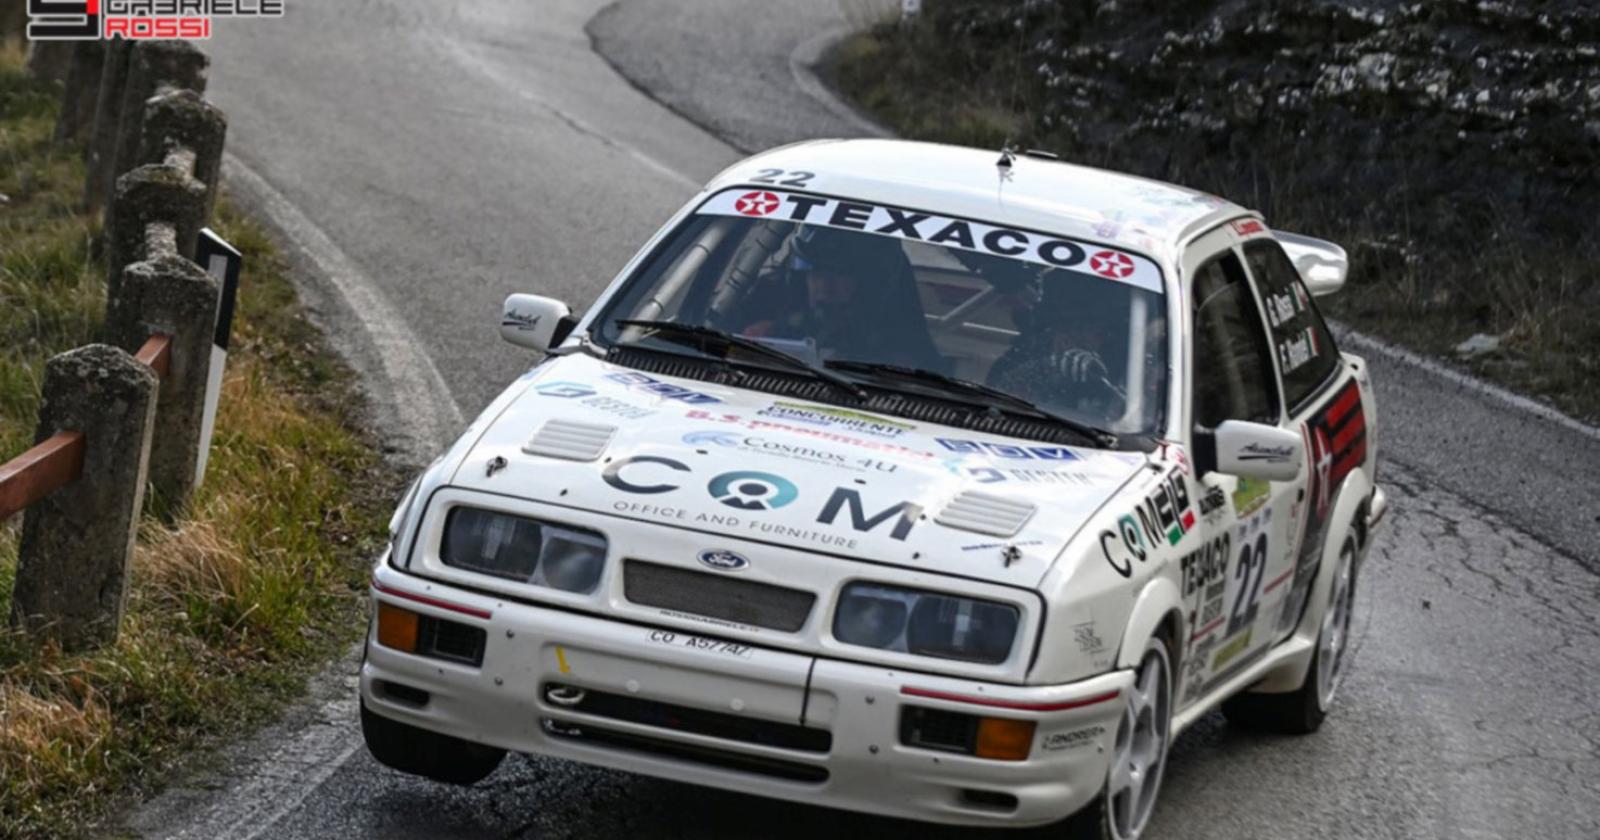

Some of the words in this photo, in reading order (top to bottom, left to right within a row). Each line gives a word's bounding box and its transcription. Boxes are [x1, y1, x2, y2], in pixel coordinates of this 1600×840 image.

[749, 168, 815, 187] 22
[785, 195, 1086, 268] TEXACO
[743, 436, 846, 463] Cosmos
[857, 458, 899, 474] 4U
[602, 455, 923, 542] COM
[613, 500, 688, 521] OFFICE
[696, 510, 741, 528] AND
[749, 522, 858, 550] FURNITURE
[702, 551, 739, 568] Ford
[1180, 531, 1231, 600] TEXACO
[1225, 532, 1268, 638] 22
[651, 630, 676, 643] CO
